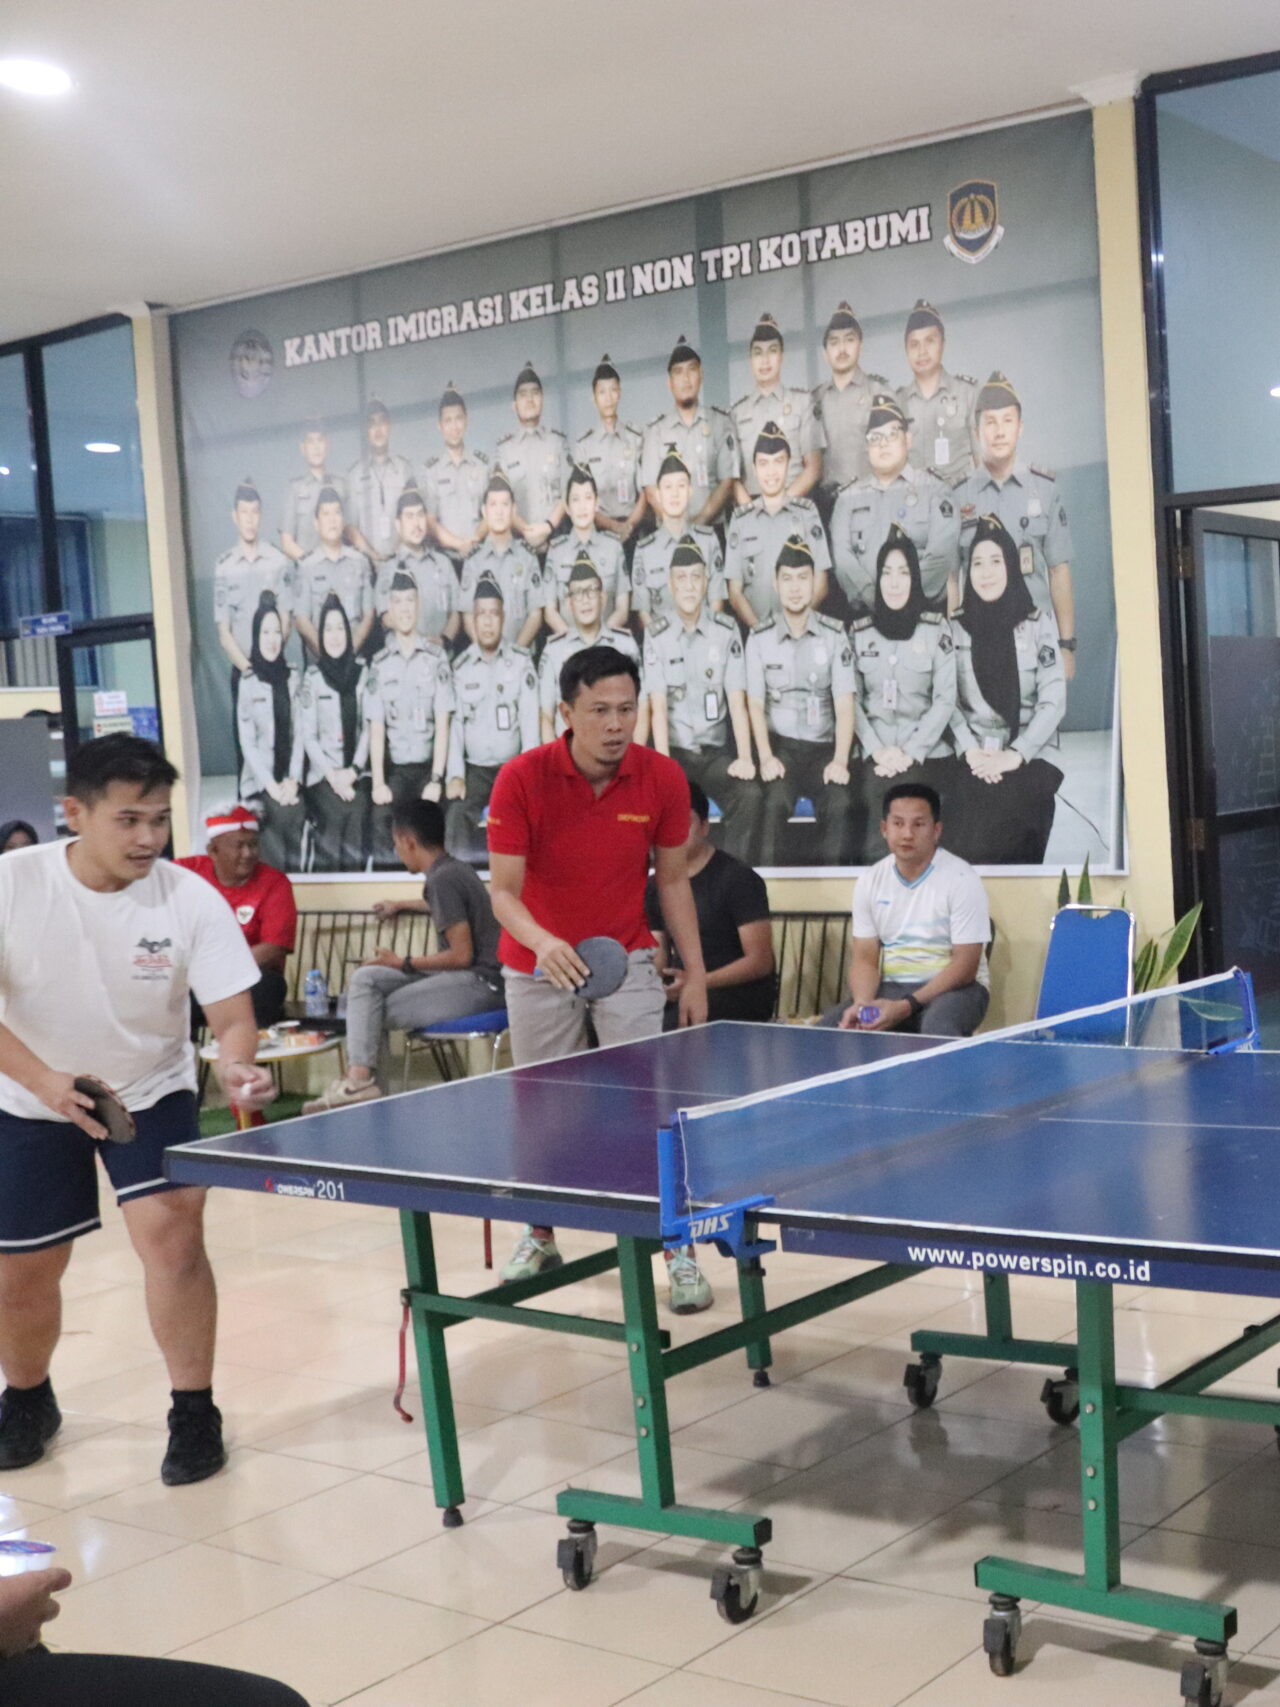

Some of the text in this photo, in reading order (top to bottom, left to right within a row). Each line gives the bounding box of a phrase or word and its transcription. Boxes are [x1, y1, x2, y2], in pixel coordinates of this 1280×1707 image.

[283, 321, 383, 367] KANTOR
[388, 295, 503, 346] IMIGRASI
[509, 275, 599, 321] KELAS
[605, 269, 626, 302] II
[632, 253, 695, 296] NON
[701, 242, 751, 281] TPI
[759, 205, 931, 272] KOTABUMI
[317, 1179, 345, 1200] 201
[688, 1212, 736, 1238] DHS
[907, 1246, 1151, 1282] www.powerspin.co.id
